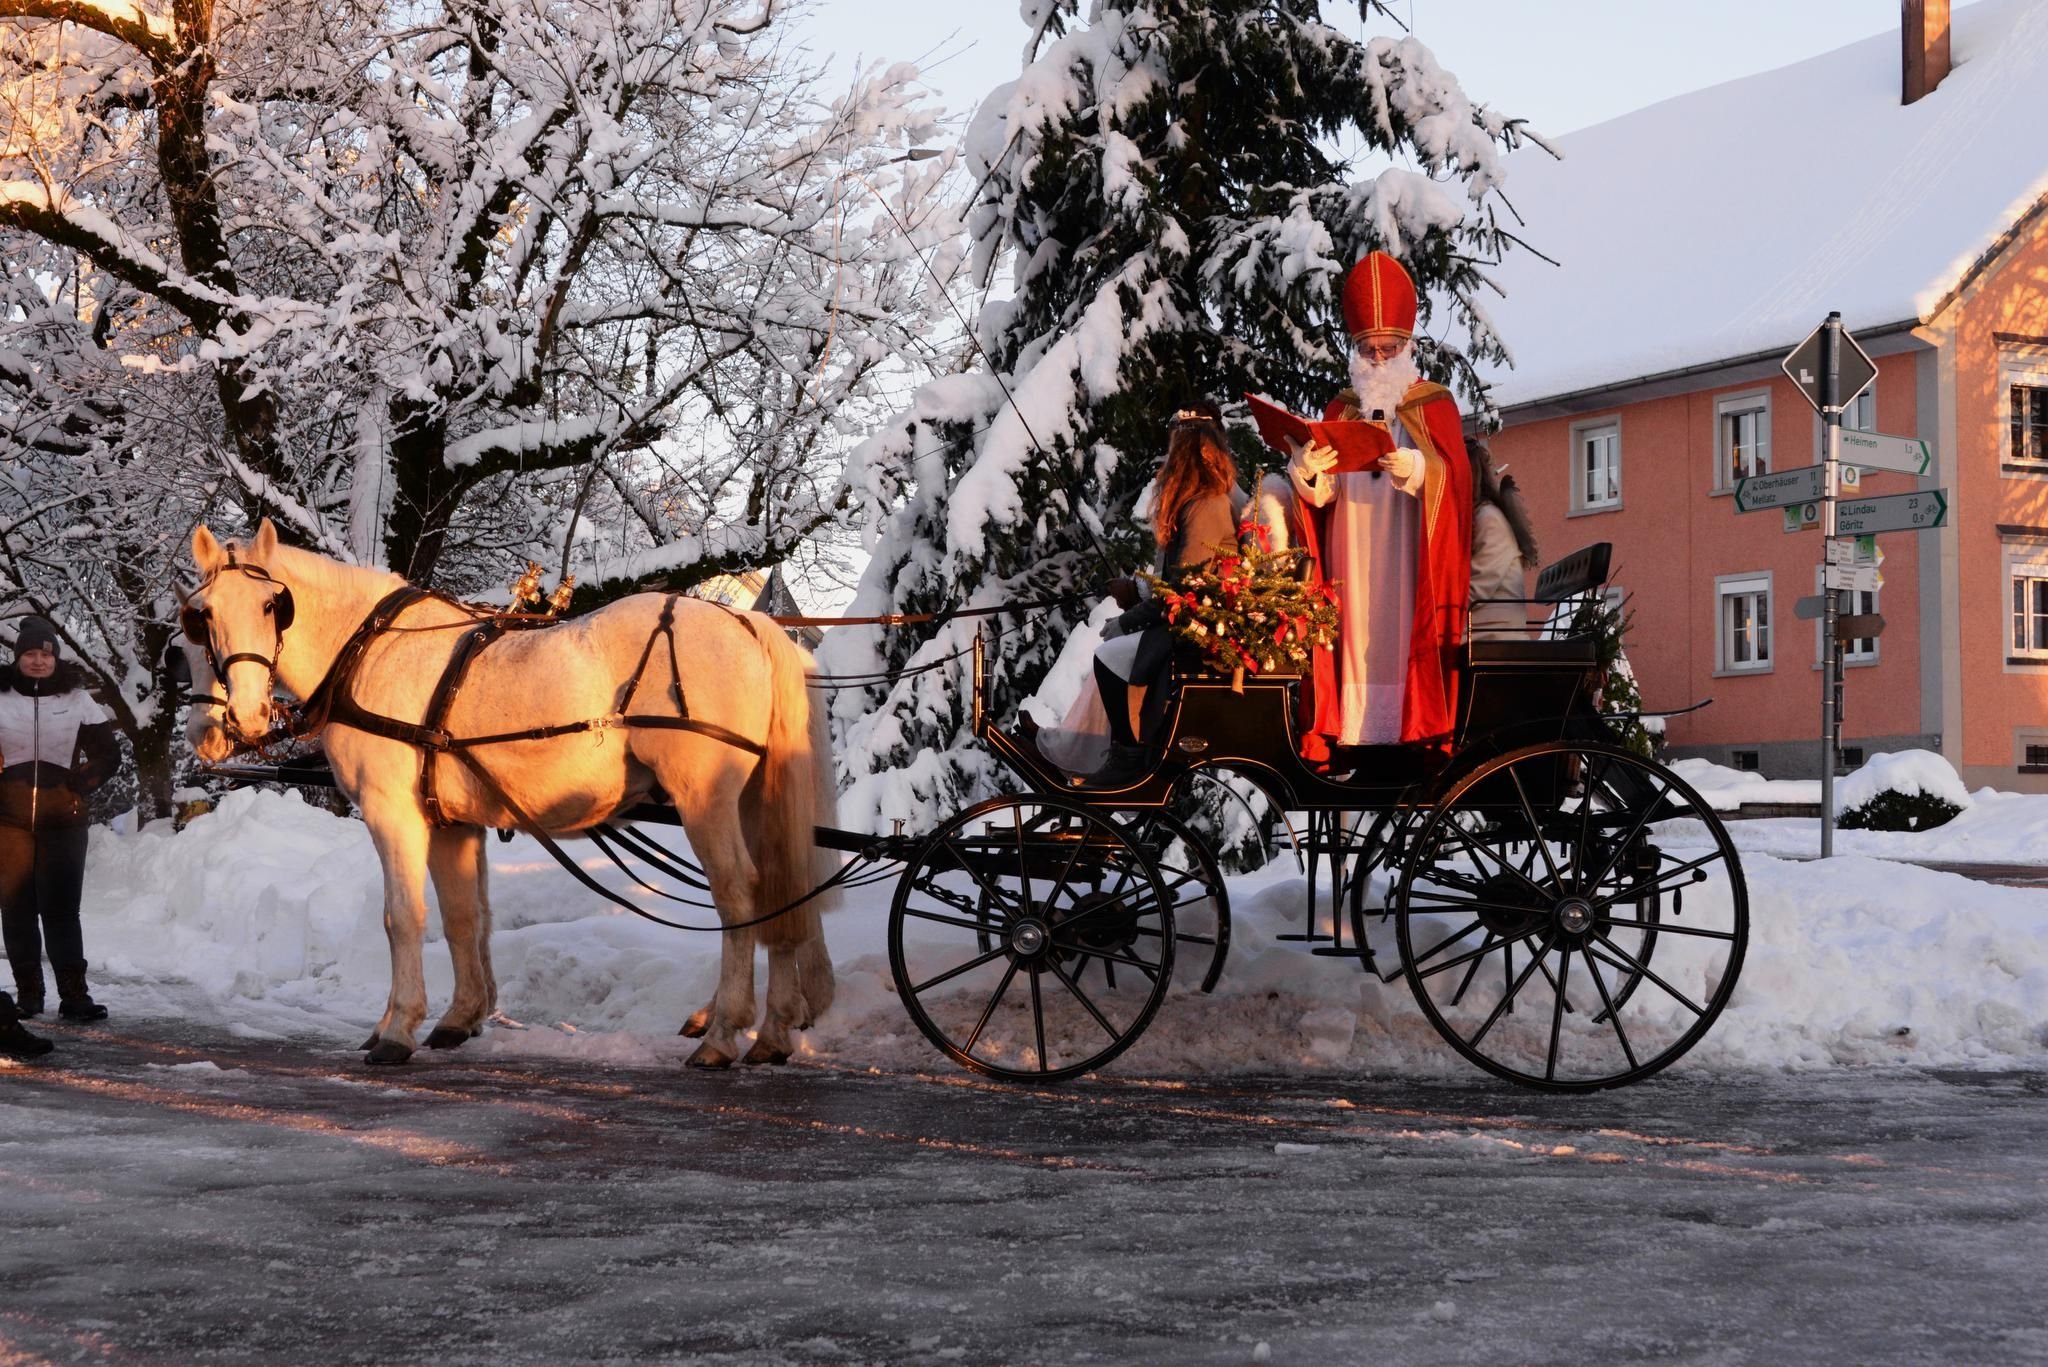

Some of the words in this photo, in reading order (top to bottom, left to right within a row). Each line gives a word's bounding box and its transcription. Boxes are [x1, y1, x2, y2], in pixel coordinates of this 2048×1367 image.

[1850, 435, 1878, 449] Heimen
[1848, 503, 1876, 516] Lindau
[1908, 497, 1919, 509] 23
[1839, 519, 1864, 531] Göritz
